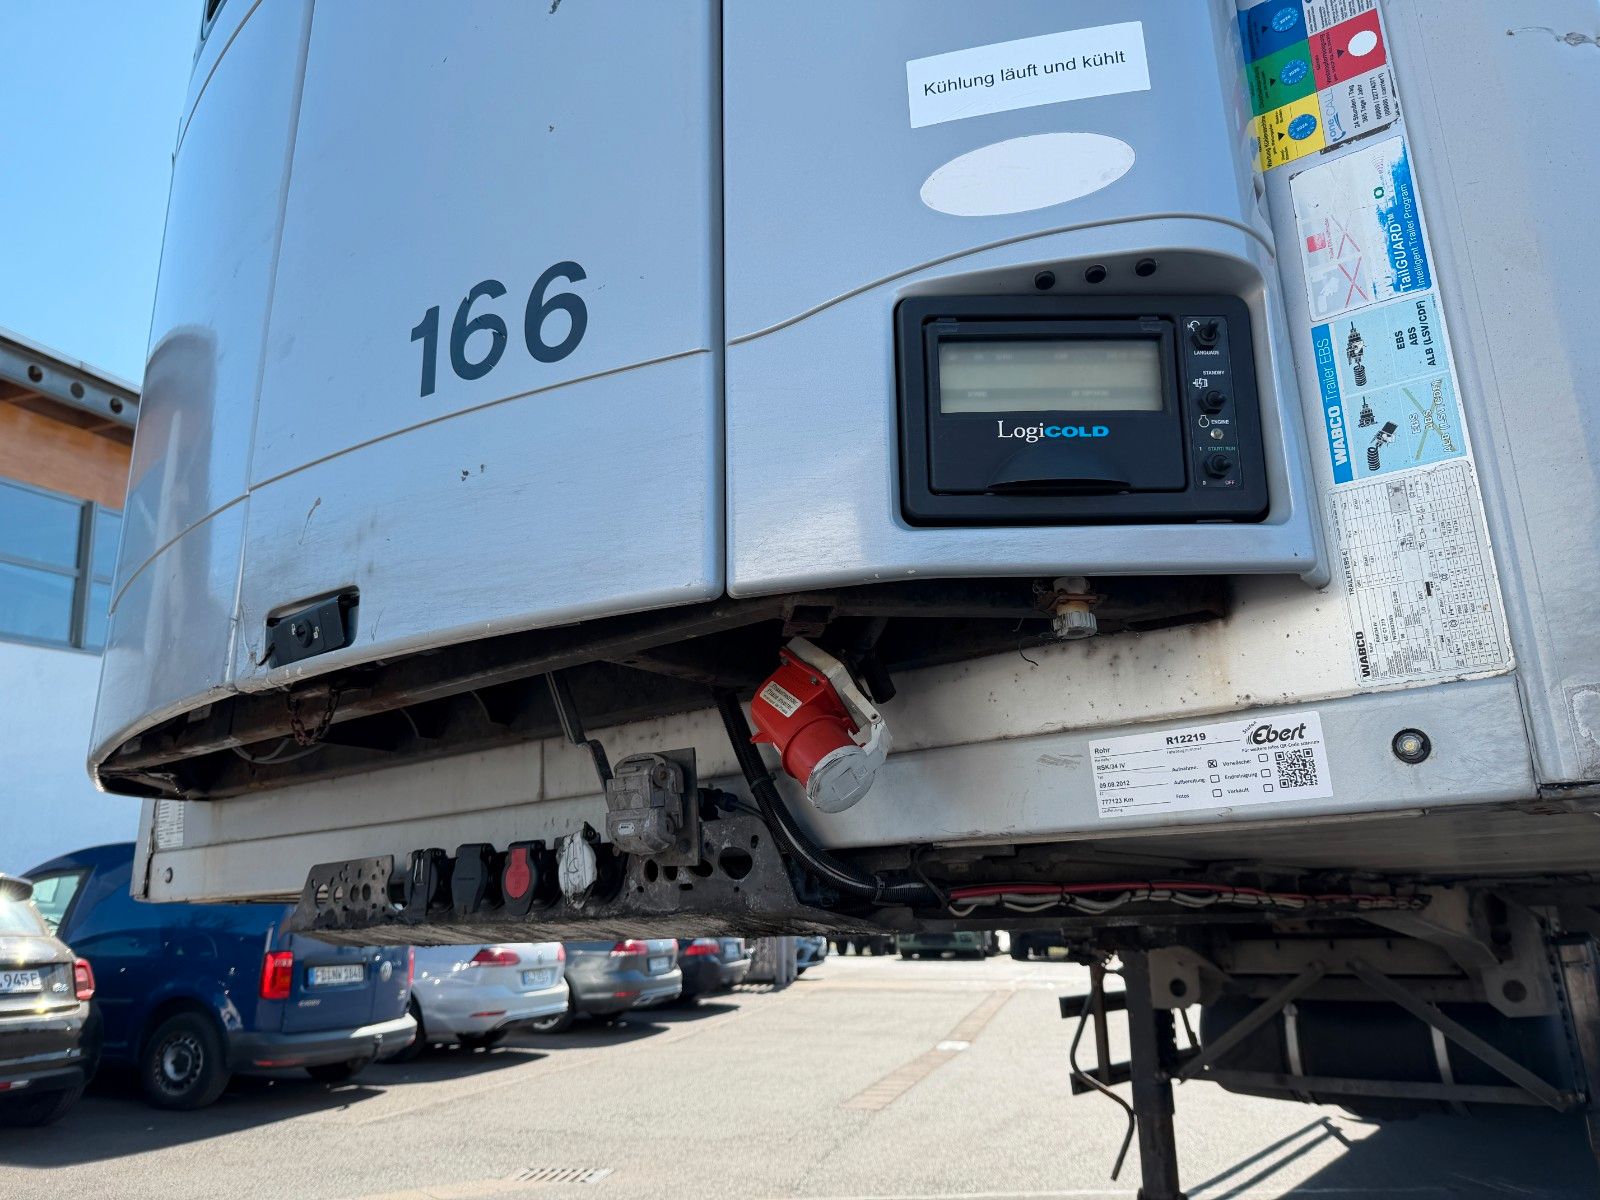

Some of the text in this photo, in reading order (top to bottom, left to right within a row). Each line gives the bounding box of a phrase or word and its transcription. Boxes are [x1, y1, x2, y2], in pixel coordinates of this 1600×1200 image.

[924, 50, 1126, 96] Kühlung läuft und kühlt
[1346, 84, 1355, 94] Tag
[1358, 99, 1367, 112] Tage
[1398, 183, 1426, 286] Intelligent Trailer Program
[411, 261, 588, 398] 166
[1394, 330, 1405, 349] EBS
[1407, 326, 1418, 345] ABS
[1415, 299, 1435, 366] ALB (LSV/CDF)
[1316, 338, 1348, 465] WABCO Trailer EBS
[1409, 412, 1420, 433] EBS
[1422, 409, 1434, 430] ABS
[997, 420, 1110, 444] LogiCOLD
[1439, 433, 1452, 453] ALB
[1345, 570, 1354, 595] TRAILER
[1355, 630, 1370, 677] WABCO
[1166, 722, 1306, 745] R12219 Ebert
[1101, 797, 1122, 805] 777123
